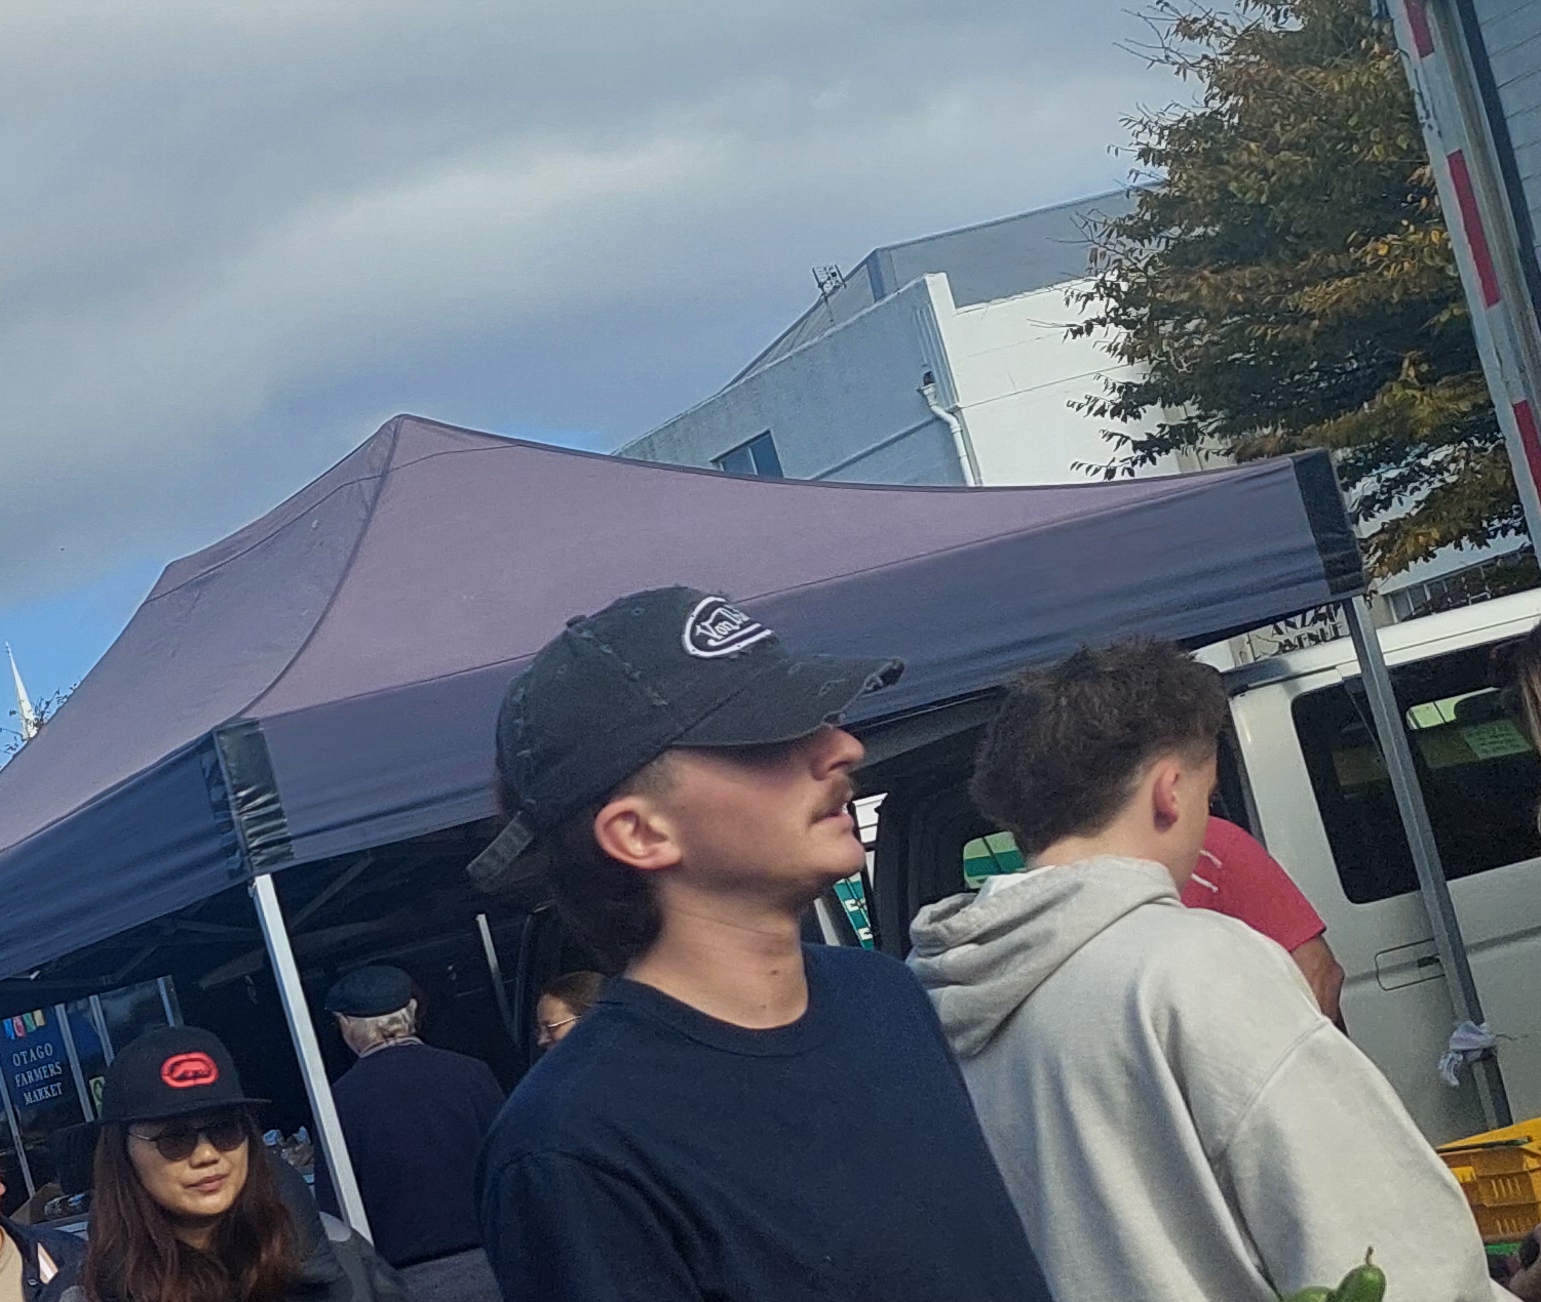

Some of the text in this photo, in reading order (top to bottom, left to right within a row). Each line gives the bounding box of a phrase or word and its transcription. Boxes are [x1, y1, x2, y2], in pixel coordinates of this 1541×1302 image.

[12, 1043, 53, 1067] OTAGO
[15, 1062, 62, 1087] FARMERS
[23, 1082, 63, 1105] MARKET
